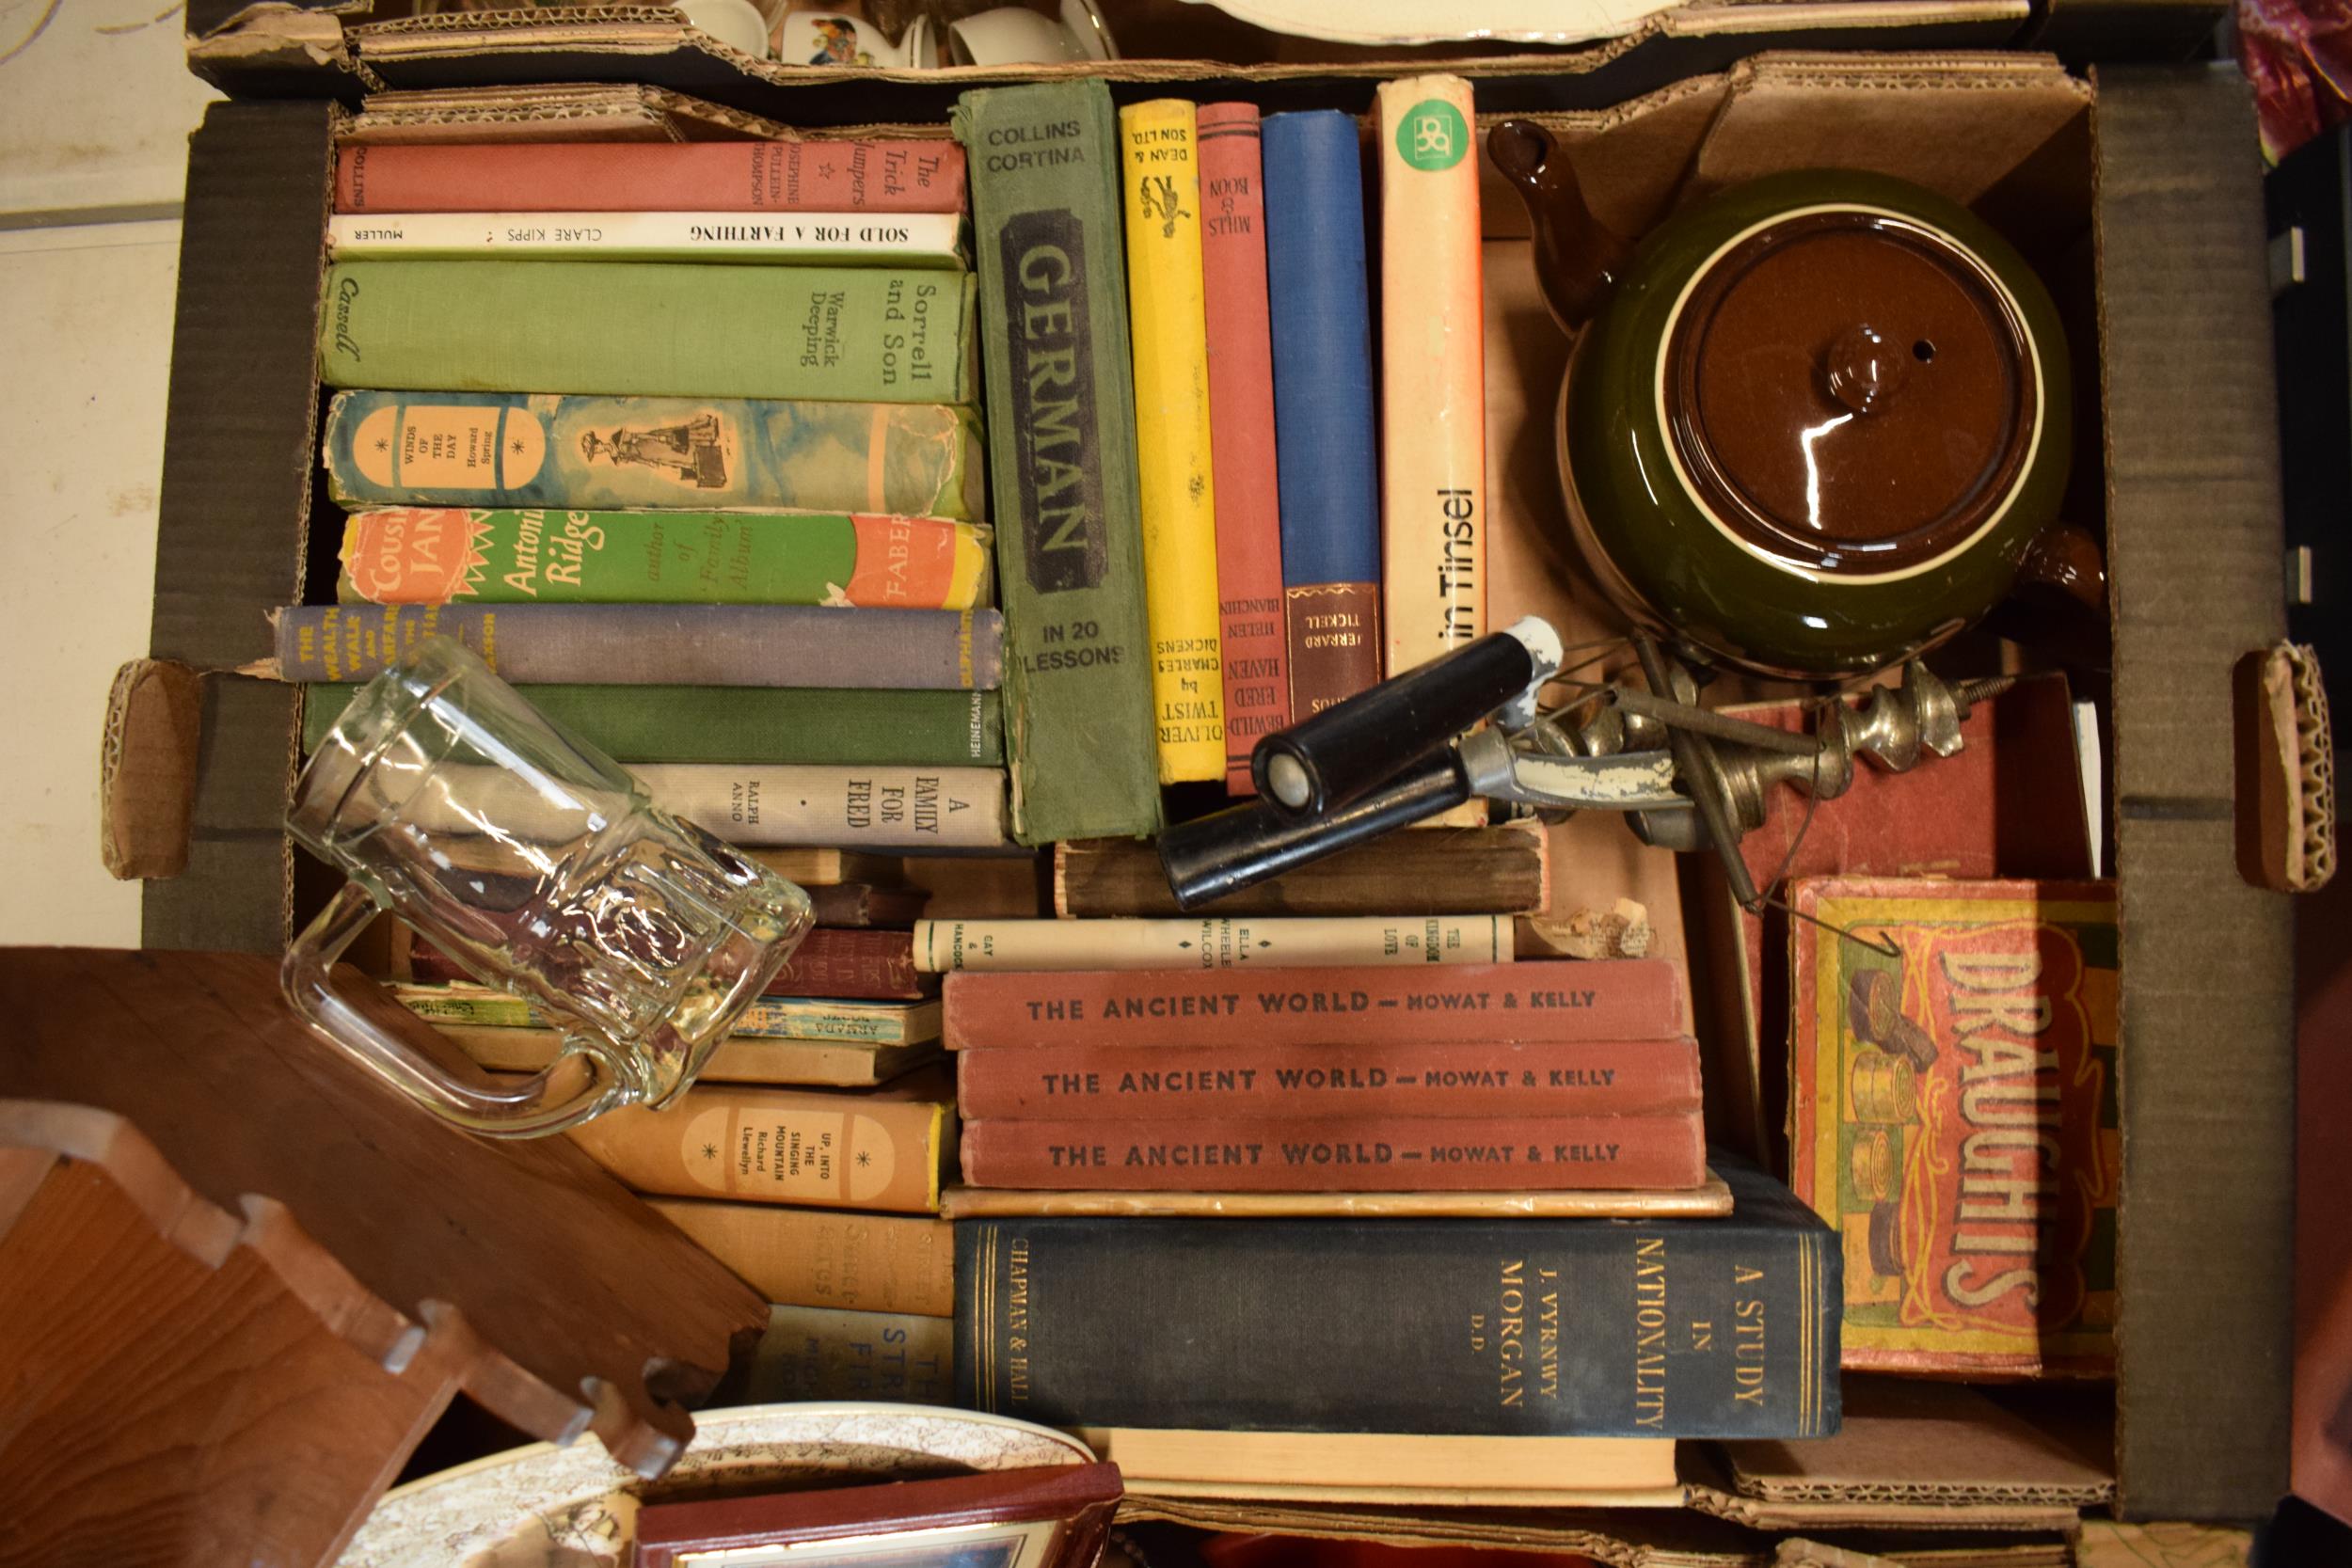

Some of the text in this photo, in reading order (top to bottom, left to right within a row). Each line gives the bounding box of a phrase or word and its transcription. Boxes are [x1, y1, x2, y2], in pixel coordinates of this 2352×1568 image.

[988, 119, 1081, 147] COLLINS
[1161, 129, 1186, 141] SON
[770, 146, 784, 204] PULLEIN-
[847, 141, 875, 207] Jumpers
[884, 150, 909, 197] Trick
[917, 156, 940, 189] The
[988, 148, 1086, 173] CORTINA
[1135, 150, 1188, 163] DEAN &
[353, 147, 368, 208] COLLINS
[1210, 177, 1249, 197] BOON
[1222, 198, 1233, 212] &
[355, 230, 403, 240] MULLER
[508, 229, 602, 241] CLARE KIPPS
[691, 226, 909, 242] SOLD FOR A FARTHING
[1208, 215, 1251, 236] MILLS
[335, 277, 362, 363] Cassell
[800, 291, 826, 368] Deeping
[824, 291, 845, 368] Warwick
[883, 279, 905, 386] and Son
[911, 284, 936, 381] Sorrell
[1018, 244, 1089, 553] GERMAN
[405, 425, 417, 465] WINDS
[420, 437, 429, 454] OF
[433, 433, 443, 459] THE
[447, 435, 457, 459] DAY
[468, 426, 478, 468] Howard
[481, 431, 493, 465] Spring
[370, 509, 407, 592] COUSI
[410, 509, 444, 576] JAN
[503, 509, 545, 596] Antoni
[546, 511, 605, 587] Ridge
[647, 522, 664, 581] author
[675, 540, 696, 563] of
[886, 514, 912, 599] FABER
[1437, 489, 1474, 639] in Tinsel
[1042, 622, 1099, 643] IN 20
[1228, 622, 1275, 638] HELEN
[1305, 613, 1360, 629] TICKELL
[299, 626, 313, 662] THE
[323, 607, 342, 681] WEALTH
[345, 615, 361, 673] WALK
[365, 629, 377, 658] AND
[1024, 645, 1124, 673] LESSONS
[1157, 639, 1217, 654] DICKENS
[1158, 658, 1219, 673] CHARLES
[1228, 658, 1279, 680] HAVEN
[1181, 677, 1198, 693] by
[1234, 687, 1276, 707] ERED
[1162, 700, 1219, 721] TWIST
[1158, 724, 1223, 743] OLIVER
[732, 783, 743, 823] ANNO
[748, 780, 760, 825] RALPH
[848, 779, 872, 829] FRED
[882, 785, 905, 824] FOR
[914, 776, 940, 834] FAMILY
[949, 798, 970, 814] A
[983, 934, 993, 957] GAY
[1201, 918, 1214, 969] WILCOX
[1220, 918, 1232, 967] WHEELE
[1239, 928, 1249, 960] ELLA
[1384, 928, 1398, 957] LOVE
[1406, 935, 1419, 949] OF
[1425, 918, 1439, 961] KINGDOM
[1447, 927, 1459, 949] THE
[1026, 1000, 1084, 1021] THE
[1103, 994, 1239, 1019] ANCIENT
[1258, 991, 1370, 1014] WORLD
[1406, 993, 1489, 1010] MOWAT
[1502, 993, 1518, 1009] &
[1531, 990, 1596, 1008] KELLY
[1042, 1074, 1100, 1094] THE
[1119, 1069, 1257, 1093] ANCIENT
[1276, 1069, 1387, 1089] WORLD
[1424, 1070, 1509, 1087] MOWAT
[1521, 1071, 1536, 1087] &
[1549, 1069, 1615, 1086] KELLY
[1938, 947, 2067, 1315] DRAUGHTS
[739, 1126, 754, 1175] Llewellyn
[756, 1131, 769, 1172] Richard
[774, 1125, 787, 1181] MOUNTAIN
[789, 1131, 801, 1176] SINGING
[804, 1145, 816, 1166] THE
[819, 1132, 832, 1180] UP, INTO
[1049, 1146, 1106, 1166] THE
[1124, 1144, 1263, 1166] ANCIENT
[1281, 1143, 1392, 1165] WORLD
[1430, 1146, 1514, 1164] MOWAT
[1526, 1146, 1542, 1163] &
[1554, 1144, 1620, 1163] KELLY
[1009, 1237, 1029, 1406] CHAPMAN & HALL
[1501, 1259, 1523, 1408] MORGAN
[1539, 1268, 1559, 1401] J. VYRNWY
[1635, 1237, 1666, 1430] NATIONALITY
[1692, 1321, 1711, 1352] IN
[1734, 1264, 1766, 1406] A STUDY
